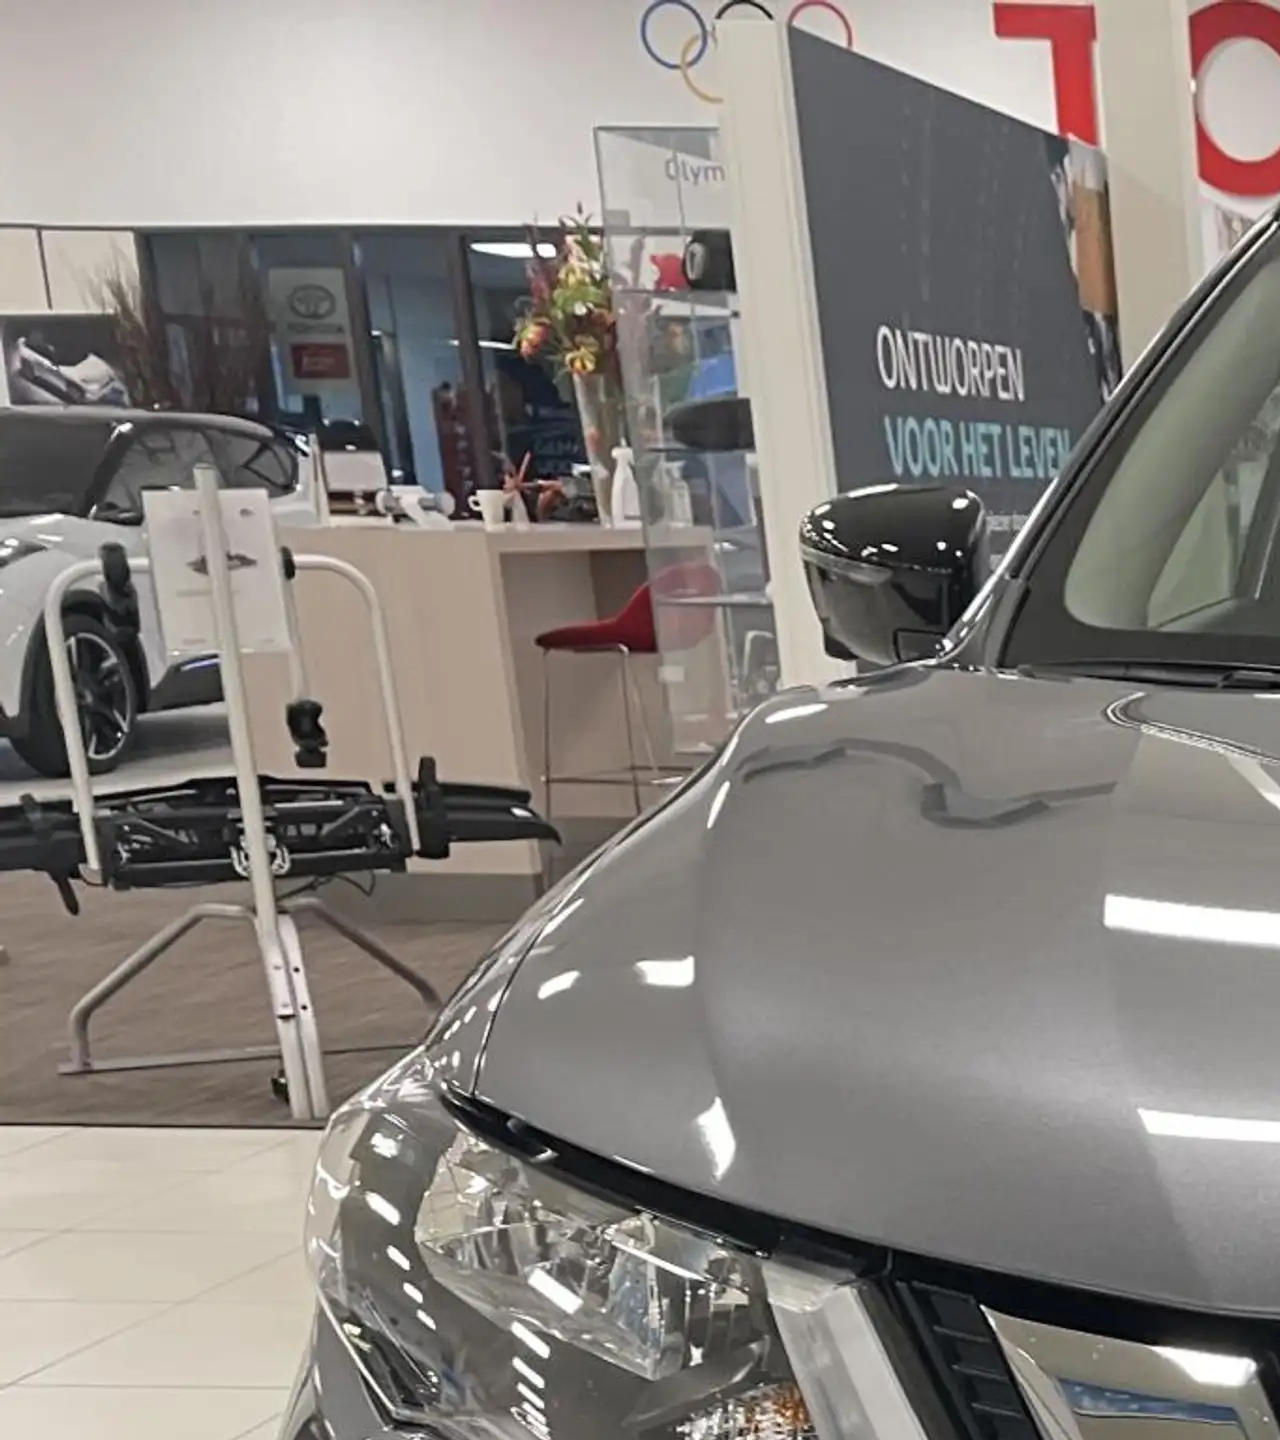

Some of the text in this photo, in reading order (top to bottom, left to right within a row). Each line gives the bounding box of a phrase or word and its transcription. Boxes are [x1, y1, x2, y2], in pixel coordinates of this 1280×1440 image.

[876, 324, 1025, 402] ONTWORPEN
[884, 414, 959, 478] VOOR
[959, 420, 1002, 478] HET
